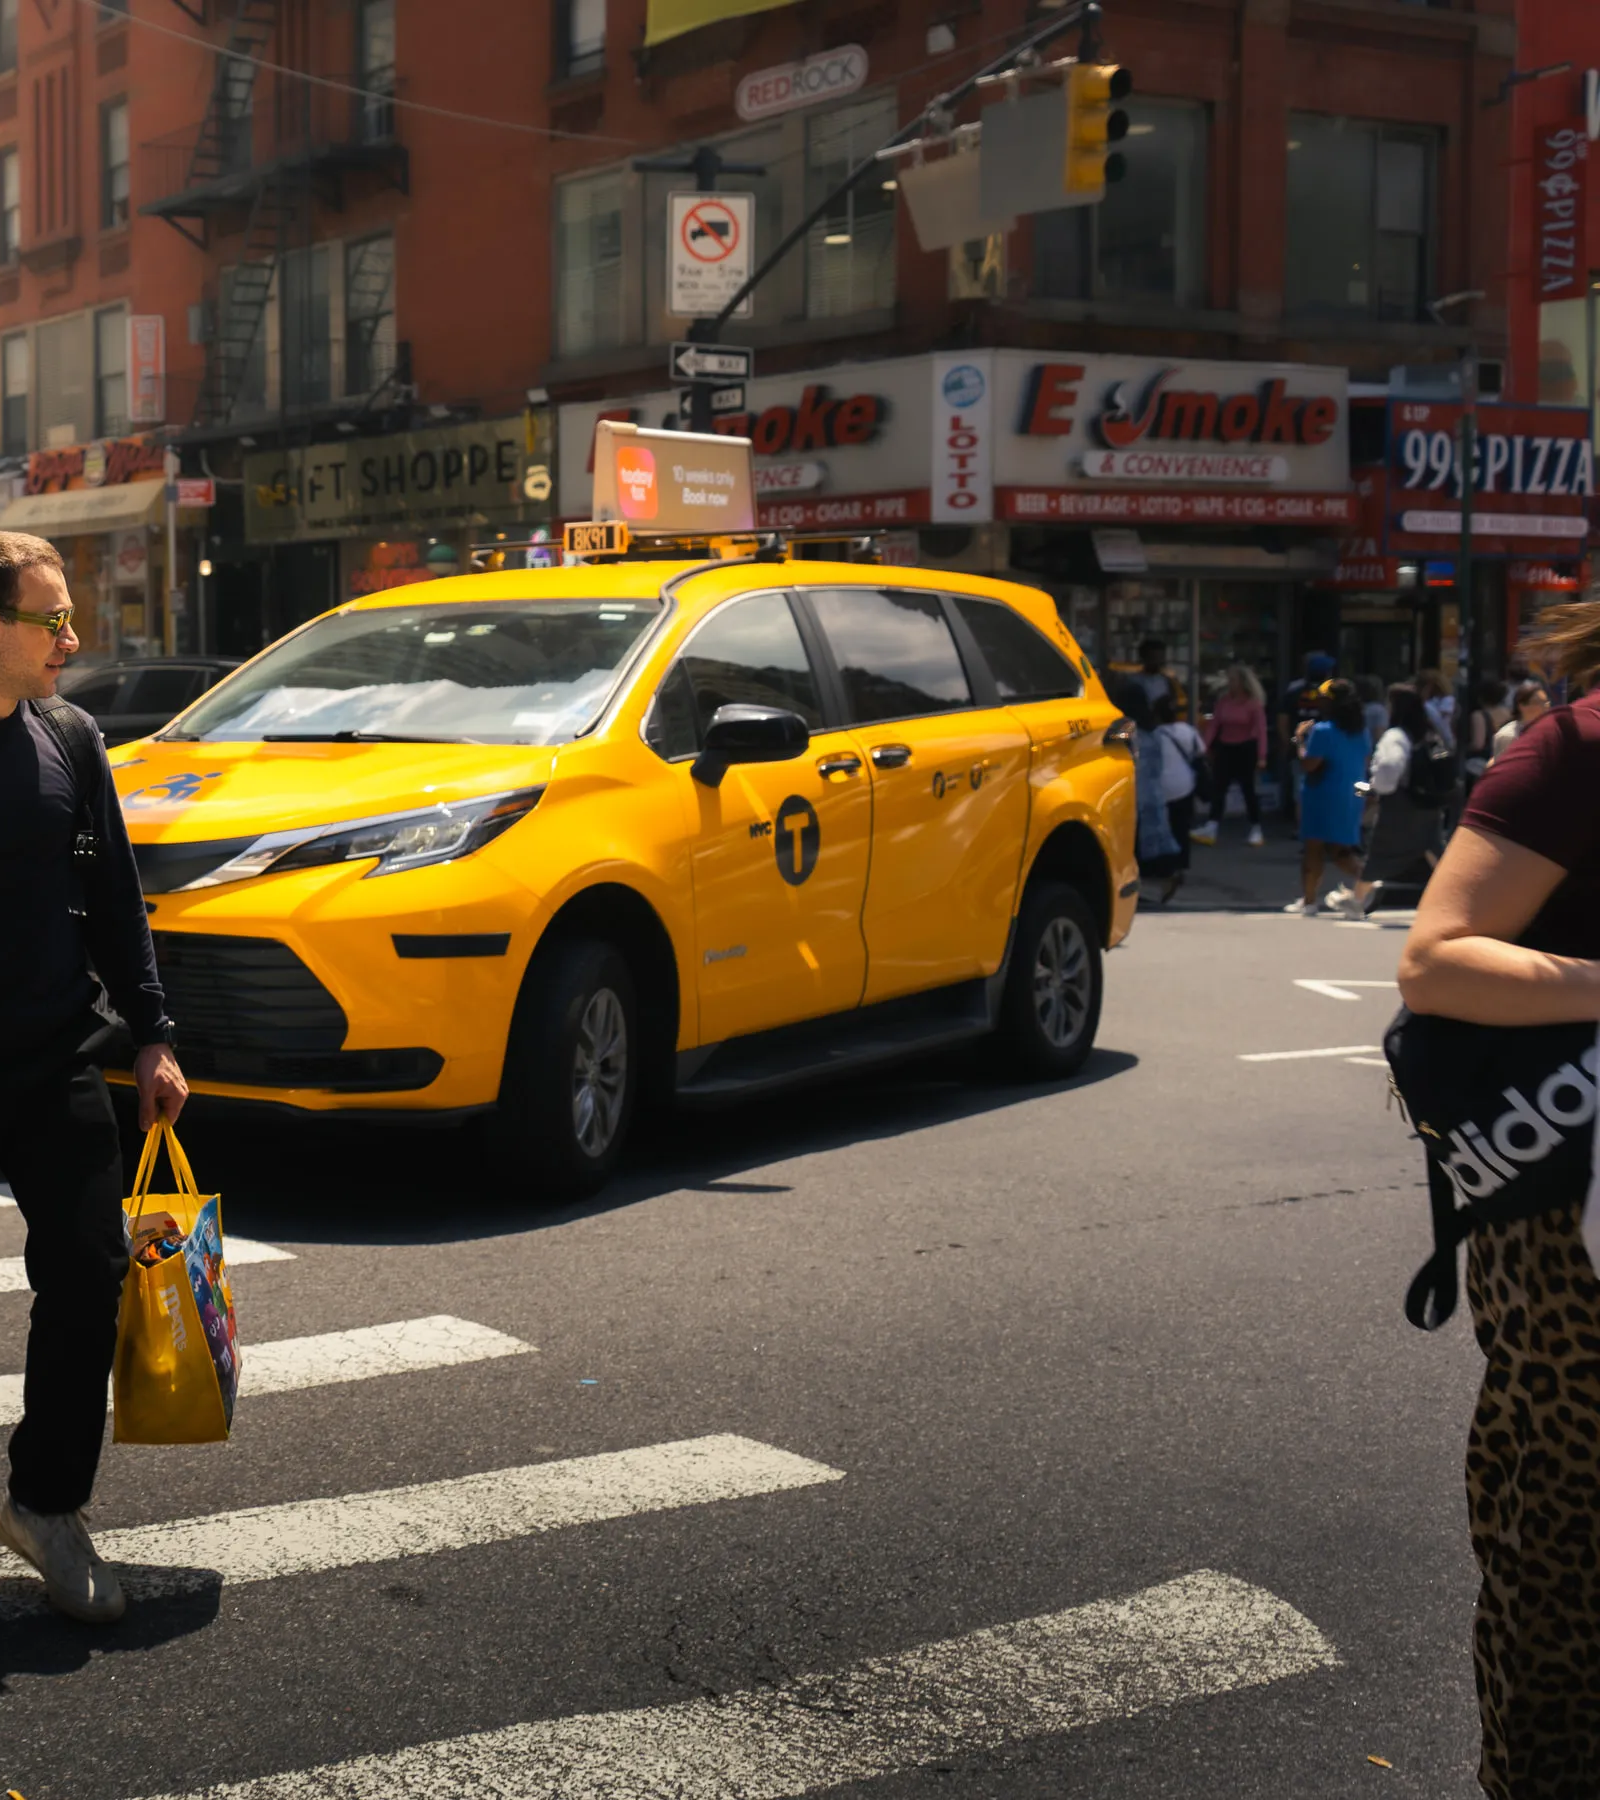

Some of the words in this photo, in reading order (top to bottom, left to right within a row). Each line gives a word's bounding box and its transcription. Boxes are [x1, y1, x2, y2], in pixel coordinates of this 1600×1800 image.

[1027, 363, 1086, 435] E
[360, 440, 518, 497] SHOPPE
[946, 414, 979, 509] LOTTO
[1099, 453, 1115, 473] &
[1123, 453, 1274, 478] CONVENIENCE
[620, 466, 654, 489] today
[672, 465, 684, 482] 10
[685, 468, 715, 484] weeks
[715, 470, 735, 487] only
[681, 487, 708, 505] Book
[708, 493, 729, 506] now
[1014, 492, 1049, 514] BEER
[1059, 494, 1130, 516] BEVERAGE
[1139, 495, 1181, 516] LOTTO
[1193, 496, 1225, 517] VAPE
[1275, 498, 1314, 519] CIGAR
[1322, 499, 1349, 519] PIPE
[816, 501, 862, 522] CIGAR
[874, 497, 907, 518] PIPE
[573, 526, 607, 551] 8K91
[748, 820, 773, 840] NYC
[783, 811, 811, 875] T
